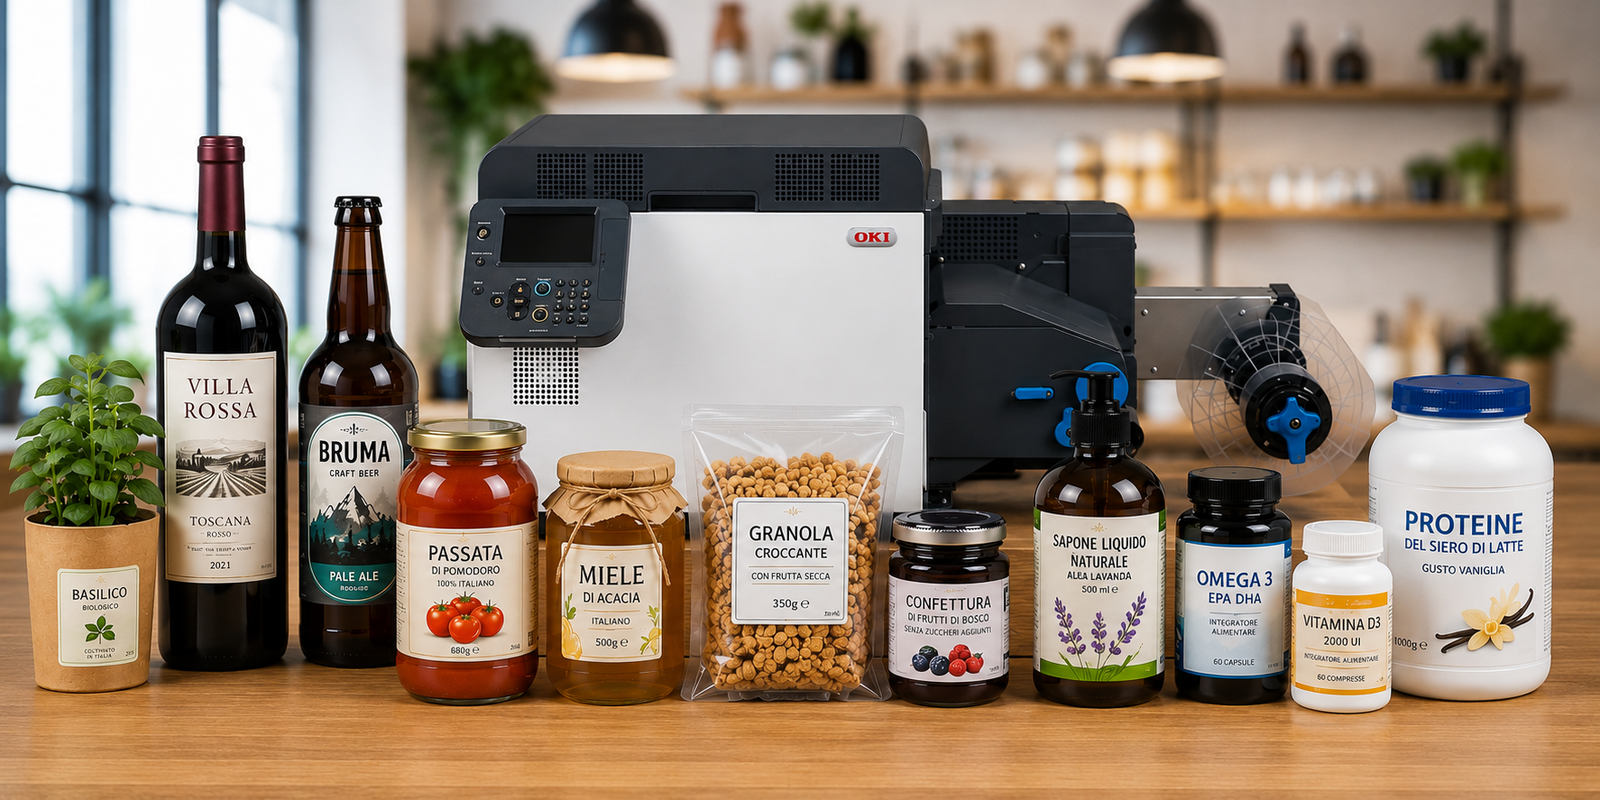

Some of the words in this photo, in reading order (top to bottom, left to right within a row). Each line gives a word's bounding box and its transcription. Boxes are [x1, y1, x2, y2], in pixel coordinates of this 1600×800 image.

[854, 231, 890, 243] OKI
[187, 377, 254, 395] VILLA
[184, 401, 257, 419] ROSSA
[319, 440, 390, 463] BRUMA
[329, 469, 355, 478] CRAFT
[358, 469, 379, 477] BEER
[189, 515, 251, 527] TOSCANA
[1405, 510, 1523, 536] PROTEINE
[749, 525, 834, 541] GRANOLA
[1053, 533, 1097, 550] SAPONE
[1102, 535, 1146, 552] LIQUIDO
[1404, 537, 1426, 551] DEL
[1429, 540, 1468, 554] SIERO
[1472, 542, 1485, 554] DI
[1489, 540, 1524, 553] LATTE
[428, 545, 503, 561] PASSATA
[755, 547, 827, 559] CROCCANTE
[210, 561, 231, 569] 2021
[1070, 554, 1128, 568] NATURALE
[431, 566, 441, 575] DI
[443, 565, 501, 575] POMODORO
[579, 565, 644, 585] MIELE
[1421, 563, 1456, 575] GUSTO
[1459, 565, 1505, 575] VANIGLIA
[329, 571, 355, 581] PALE
[359, 571, 379, 581] ALE
[751, 572, 769, 580] CON
[771, 572, 802, 580] FRUTTA
[804, 572, 831, 580] SECCA
[1090, 571, 1132, 580] LAVANDA
[1197, 570, 1260, 588] OMEGA
[1264, 571, 1273, 586] 3
[72, 587, 128, 601] BASILICO
[1081, 585, 1098, 593] 500
[1099, 585, 1110, 593] ml
[583, 592, 594, 603] DI
[597, 592, 641, 604] ACACIA
[905, 594, 991, 611] CONFETTURA
[1208, 592, 1232, 604] EPA
[1235, 592, 1262, 604] DHA
[82, 603, 119, 611] BIOLOGICO
[772, 599, 798, 611] 350g
[591, 617, 631, 625] ITALIANO
[907, 612, 916, 621] DI
[917, 613, 948, 625] FRUTTI
[950, 616, 959, 625] DI
[962, 613, 990, 624] BOSCO
[1209, 618, 1258, 627] INTEGRATORE
[1303, 614, 1365, 631] VITAMINA
[1367, 616, 1381, 630] D3
[904, 624, 924, 634] SENZA
[925, 626, 959, 636] ZUCCHERI
[960, 626, 991, 636] AGGIUNTI
[595, 637, 618, 649] 500g
[1323, 636, 1348, 646] 2000
[1351, 637, 1361, 646] UI
[1394, 636, 1418, 651] 1000g
[450, 646, 471, 656] 680g
[1213, 658, 1222, 666] 60
[1223, 658, 1255, 666] CAPSULE
[1317, 673, 1326, 681] 60
[1326, 674, 1365, 682] COMPRESSE
